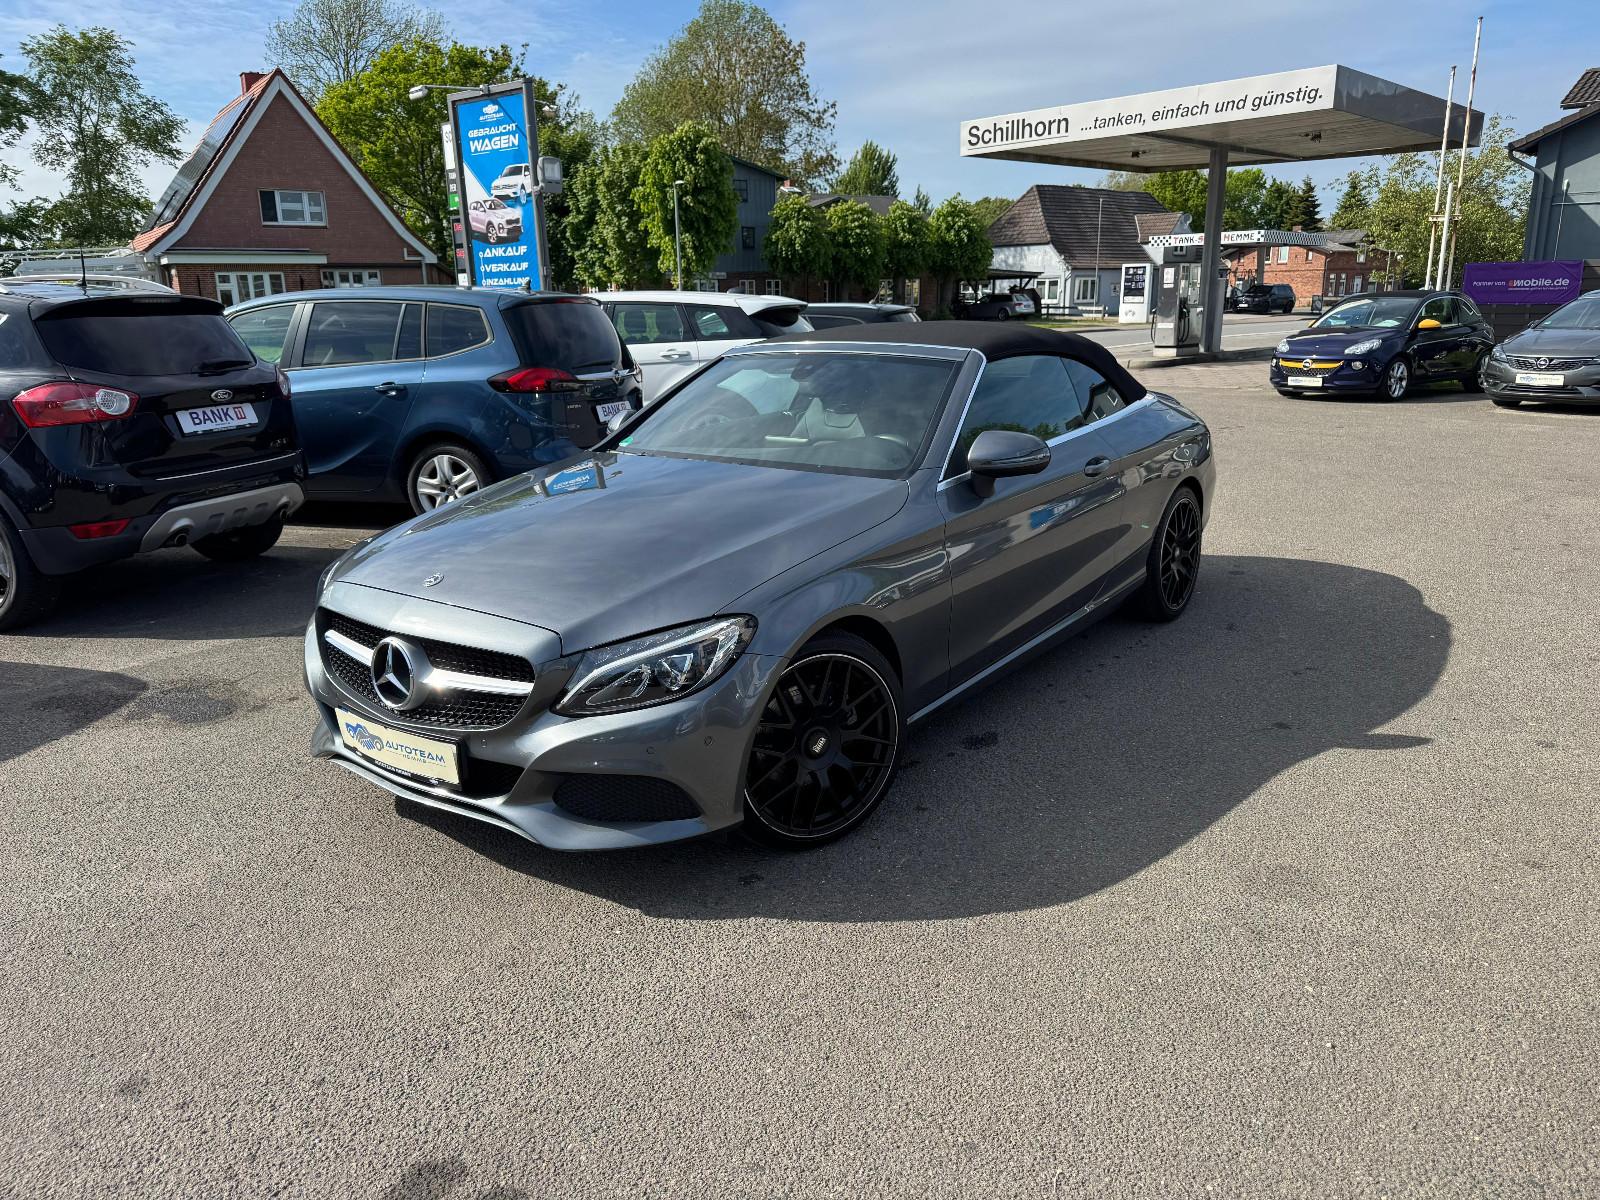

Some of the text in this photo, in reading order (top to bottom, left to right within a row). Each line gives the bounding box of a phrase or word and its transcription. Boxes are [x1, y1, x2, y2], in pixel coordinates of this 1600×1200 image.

[967, 85, 1324, 147] Schillhorn ...tanken, einfach und günstig.
[467, 123, 518, 138] GEBRAUCHT
[469, 133, 519, 153] WAGEN
[1223, 232, 1255, 242] HEMME
[483, 245, 528, 258] ANKAUF
[484, 262, 529, 273] VERKAUF
[188, 407, 234, 426] BANK
[601, 401, 621, 417] BANK
[385, 740, 447, 764] AUTOTEAM
